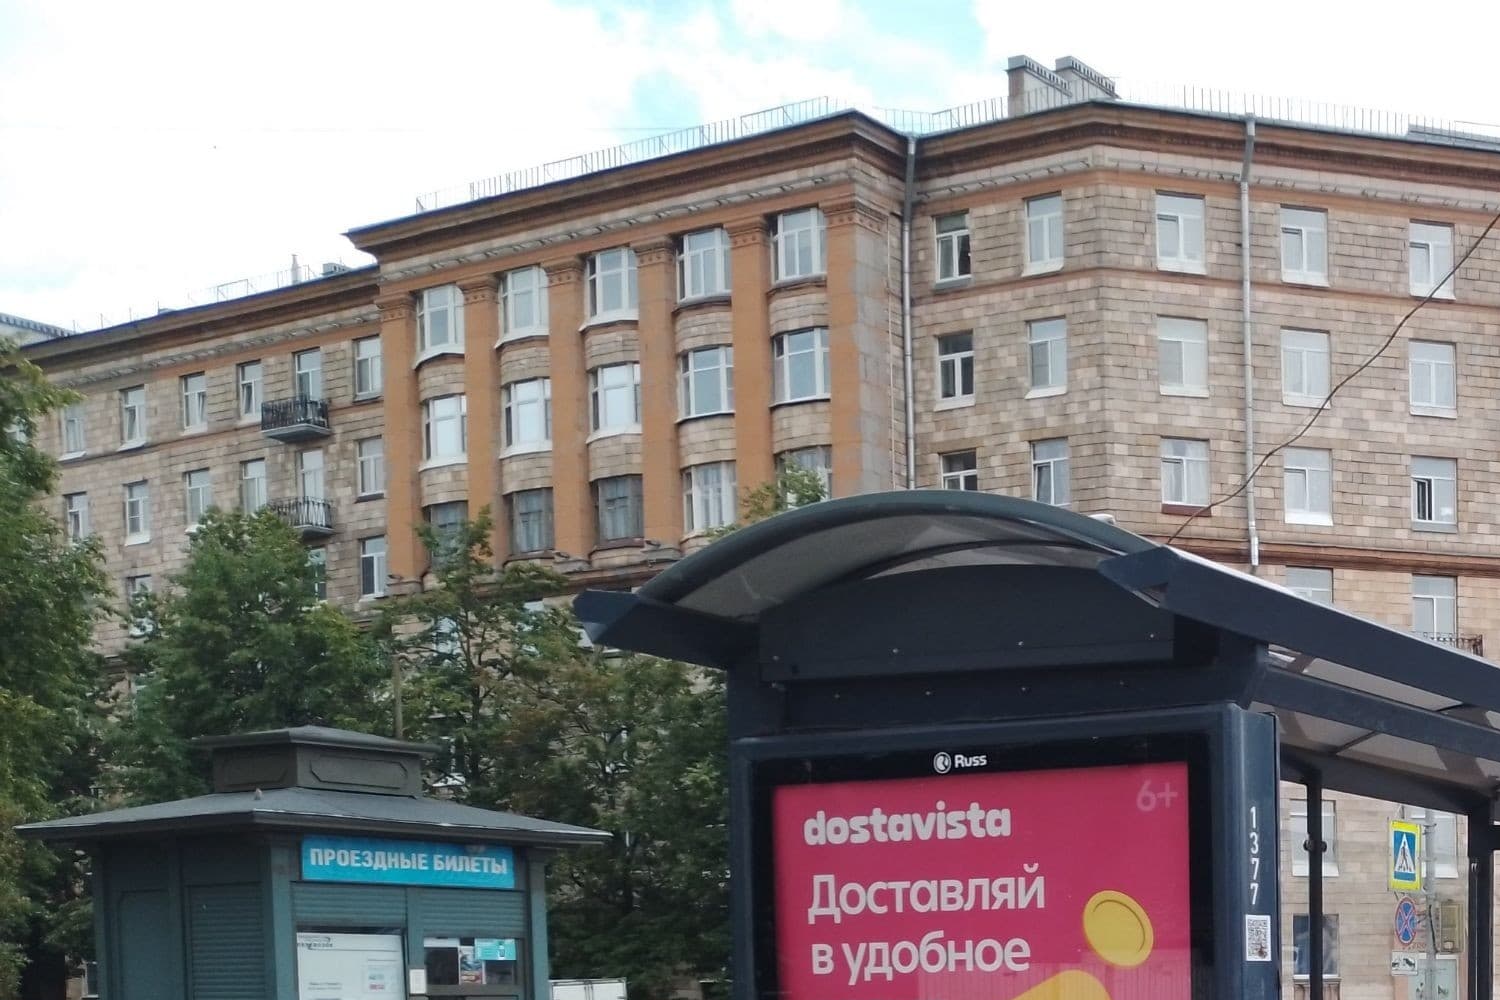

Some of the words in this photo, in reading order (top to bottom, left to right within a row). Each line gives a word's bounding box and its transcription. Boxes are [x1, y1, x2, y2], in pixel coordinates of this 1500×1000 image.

[954, 753, 987, 769] Russ
[1136, 780, 1178, 812] 6+
[803, 801, 1012, 846] dostavista
[310, 848, 428, 871] ПРОЕЗДНЫЕ
[433, 854, 508, 874] БИЛЕТЫ
[1249, 806, 1260, 905] 1377
[808, 863, 1046, 924] Доставляй
[811, 942, 834, 975] в
[844, 931, 1031, 985] удобное
